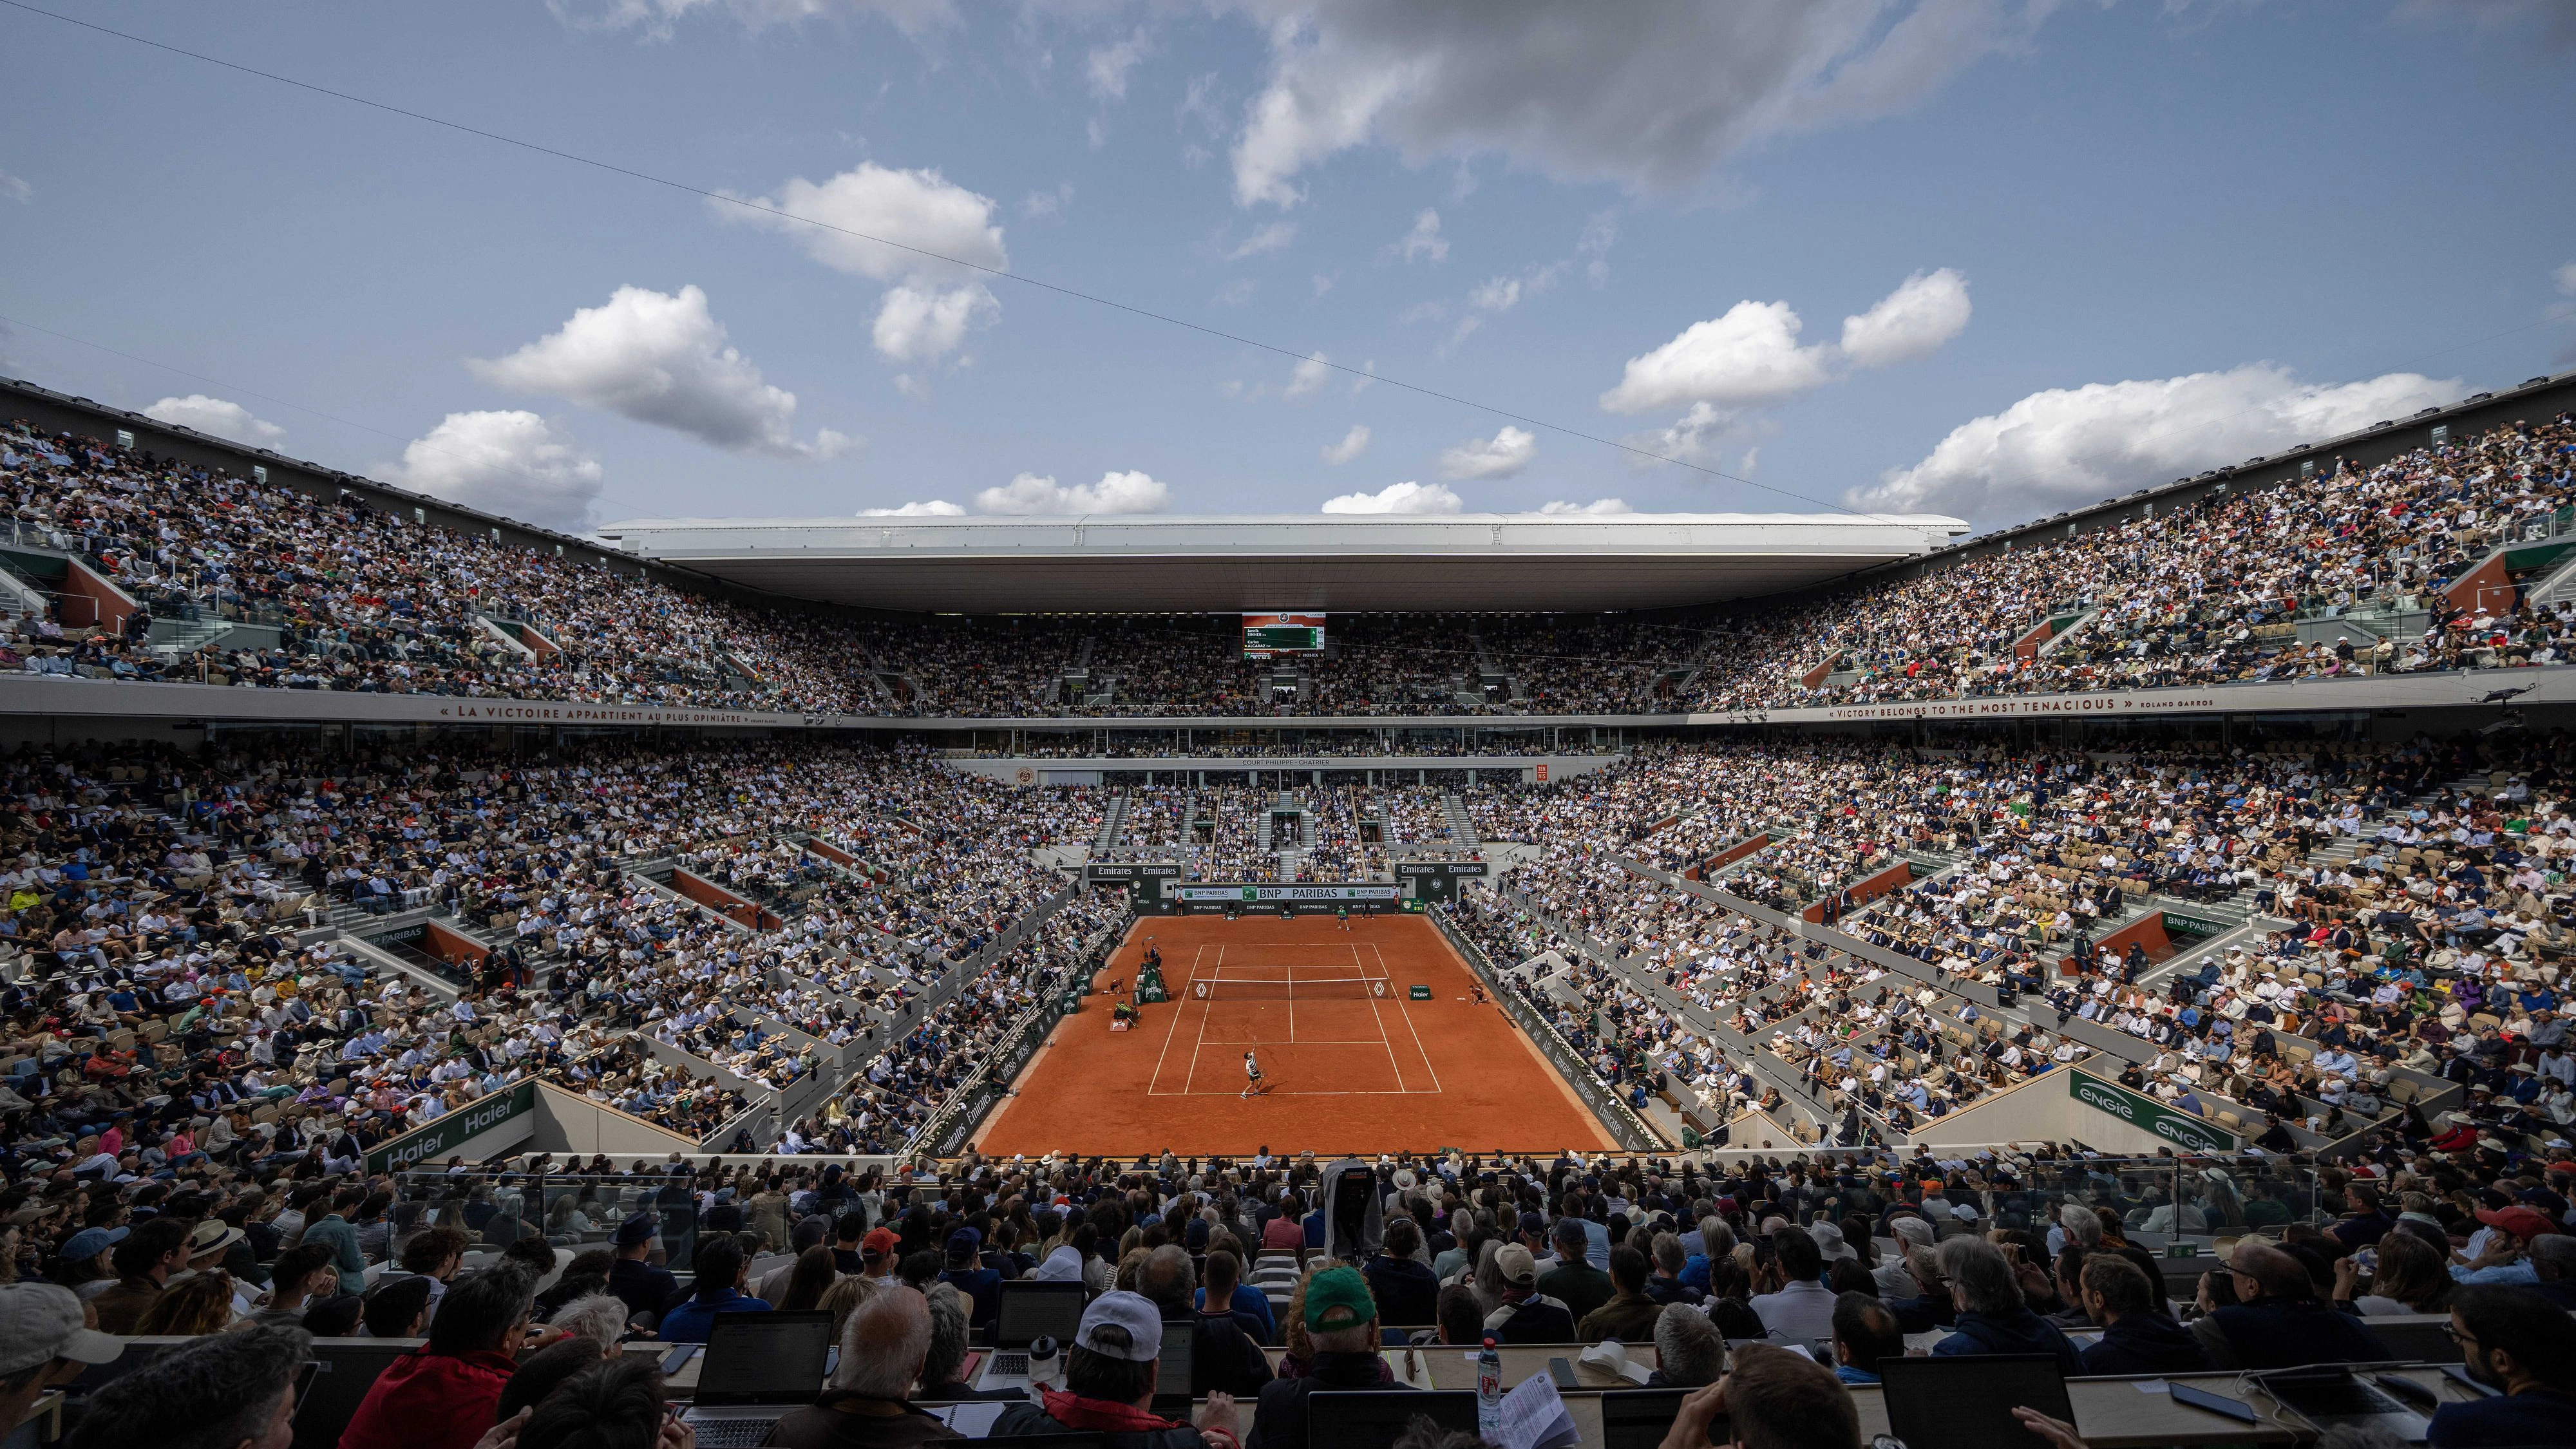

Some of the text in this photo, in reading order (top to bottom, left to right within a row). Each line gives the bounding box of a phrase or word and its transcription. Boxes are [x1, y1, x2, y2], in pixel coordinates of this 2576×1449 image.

[459, 706, 477, 717] LA
[487, 707, 559, 718] VICTOIRE
[567, 710, 642, 720] APPARTIENT
[694, 713, 740, 722] OPINIÂTRE
[1837, 710, 1876, 718] VICTORY
[1880, 707, 1926, 717] BELONGS
[1933, 706, 1945, 715] TO
[1953, 705, 1973, 714] THE
[1981, 703, 2015, 713] MOST
[2023, 699, 2114, 712] TENACIOUS
[651, 871, 671, 880] PARIBAS
[1260, 889, 1337, 898] BNP PARIBAS
[2168, 917, 2228, 934] BNP PARIBA
[366, 928, 421, 946] NP PARIBAS
[1464, 949, 1475, 963] RENAULT
[1478, 965, 1490, 980] RENAULT
[1554, 1052, 1572, 1078] Emirates
[1575, 1075, 1595, 1105] Emirates
[465, 1100, 512, 1134] Haier
[966, 1092, 991, 1125] Emirates
[1598, 1102, 1622, 1136] Emirates
[938, 1123, 966, 1155] Emirates
[1626, 1134, 1642, 1150] Emi
[388, 1132, 444, 1172] Haier
